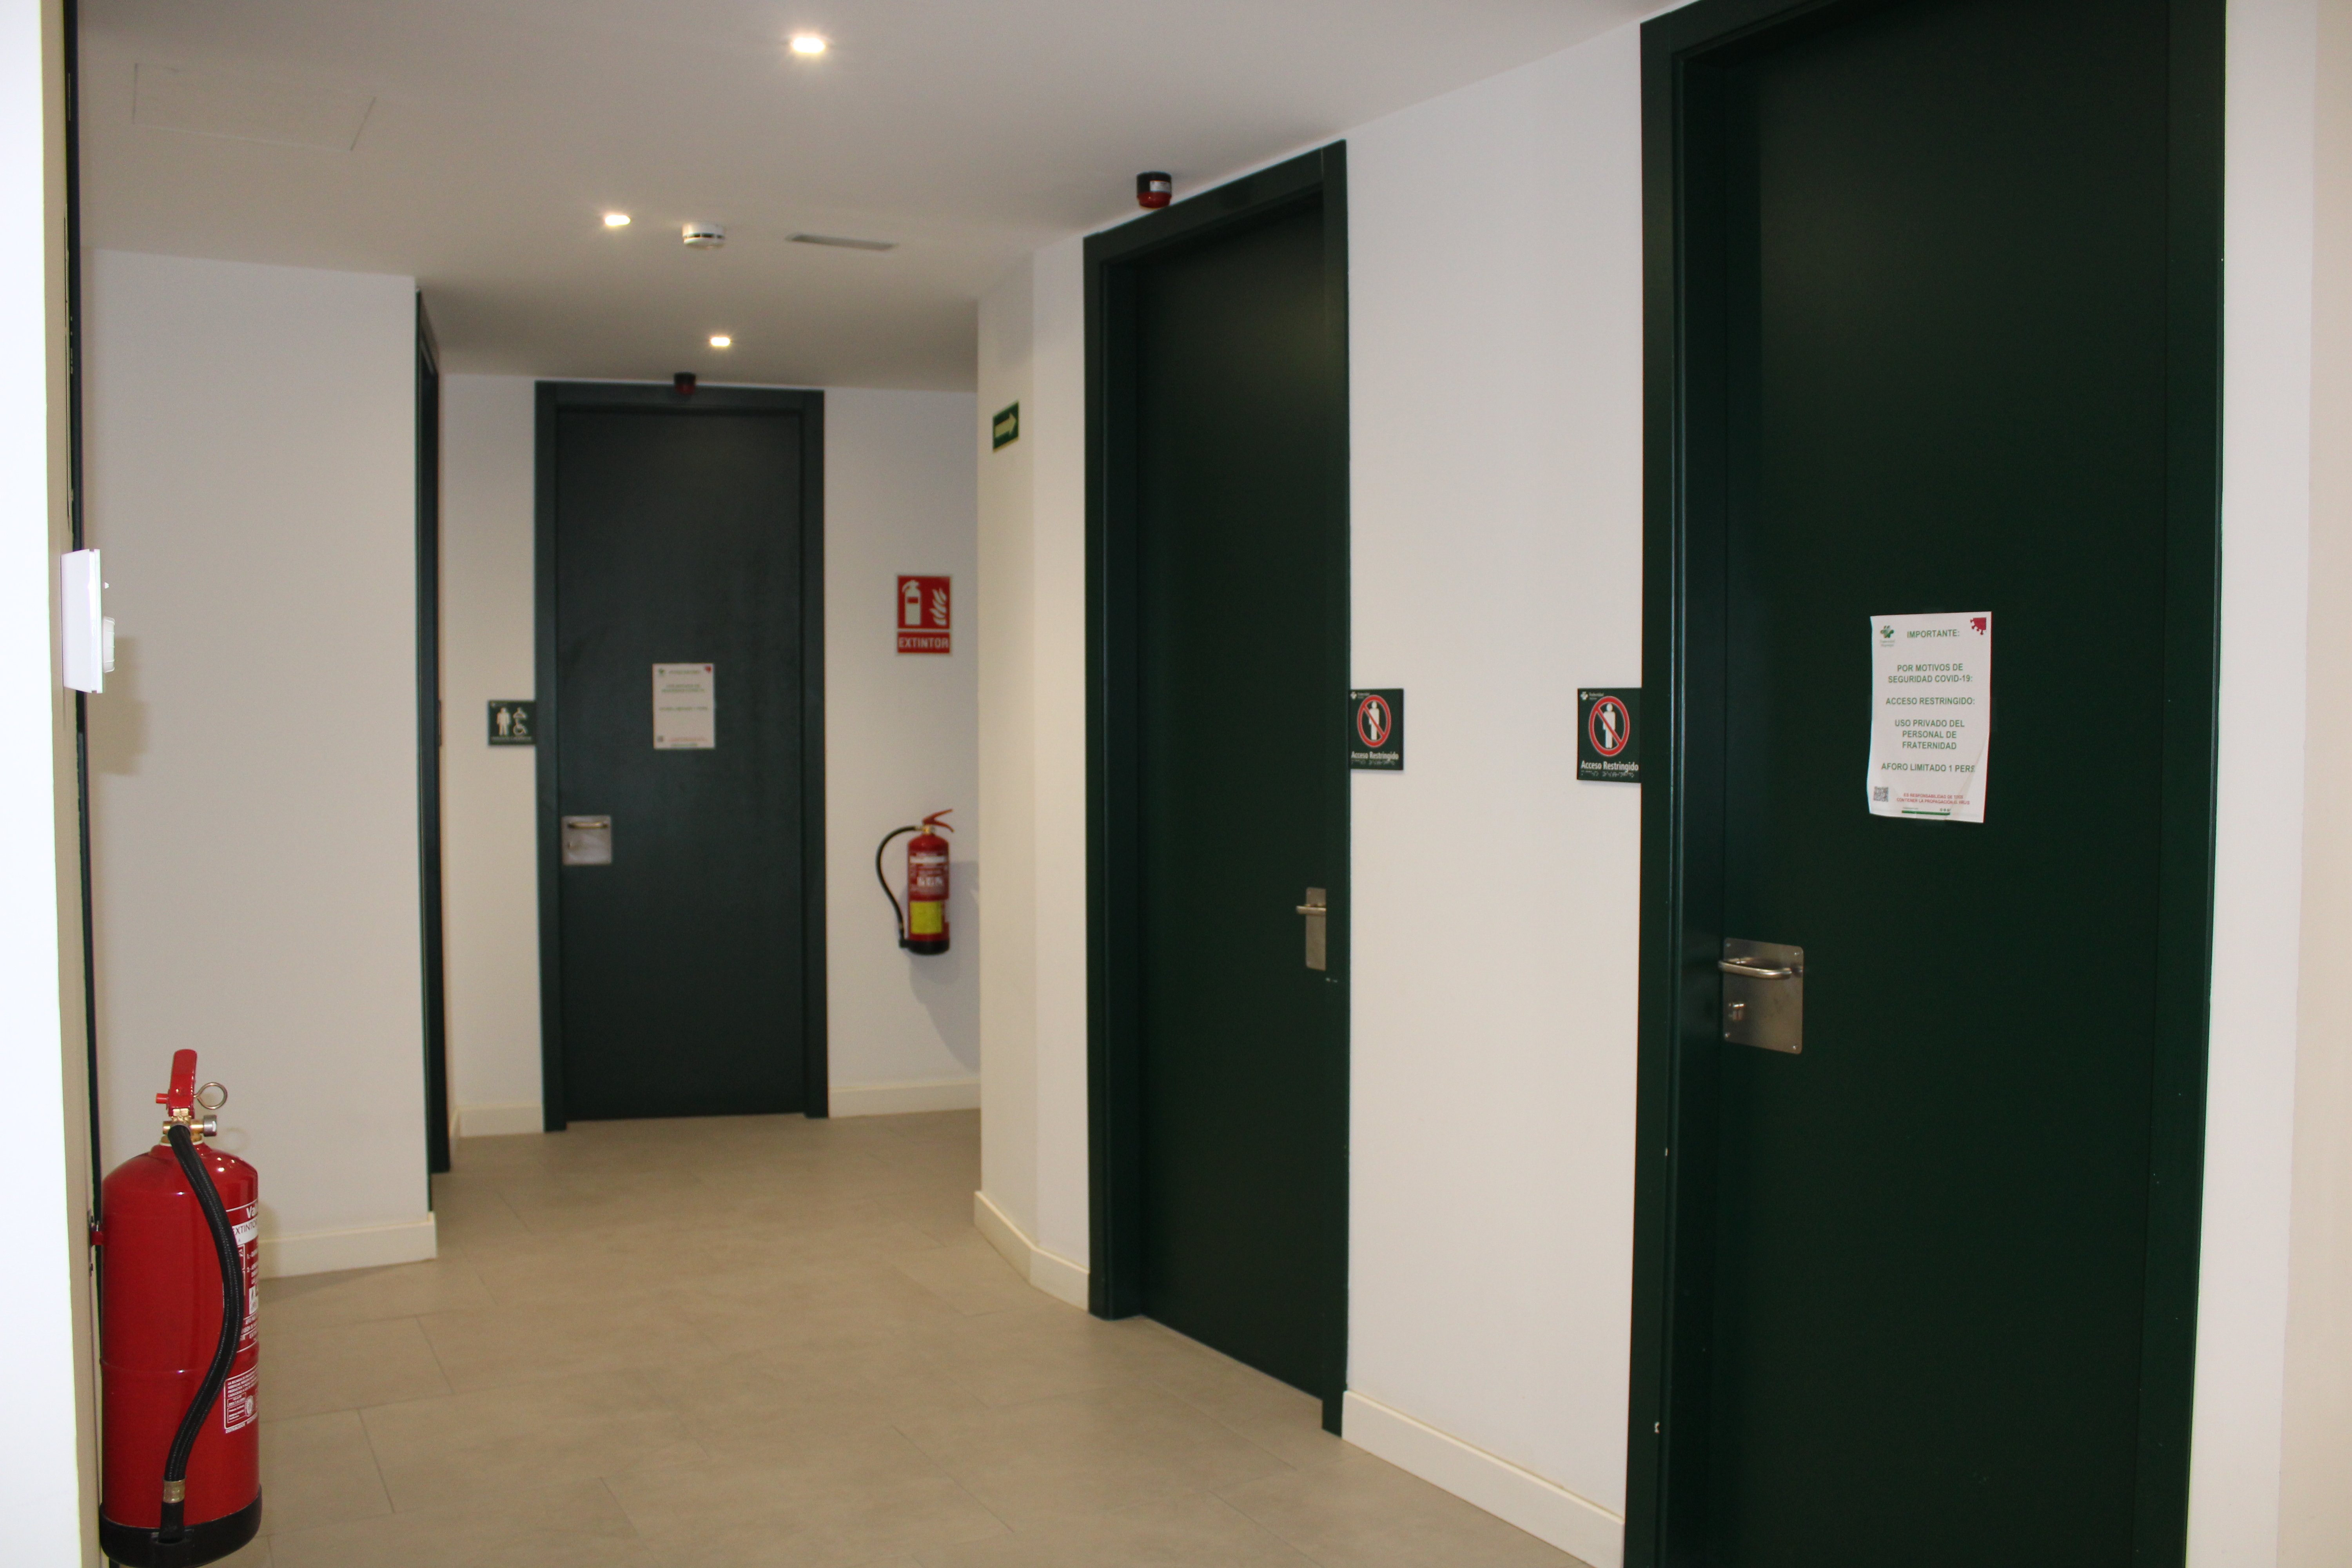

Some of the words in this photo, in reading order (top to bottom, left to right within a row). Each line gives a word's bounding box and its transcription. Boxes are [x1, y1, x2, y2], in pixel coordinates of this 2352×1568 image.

[1907, 629, 1960, 638] IMPORTANTE:
[899, 637, 948, 648] EXTINTOR
[1351, 751, 1368, 759] Acceso
[1370, 751, 1399, 761] Restringido
[1581, 760, 1602, 769] Acceso
[1603, 761, 1639, 772] Restringido
